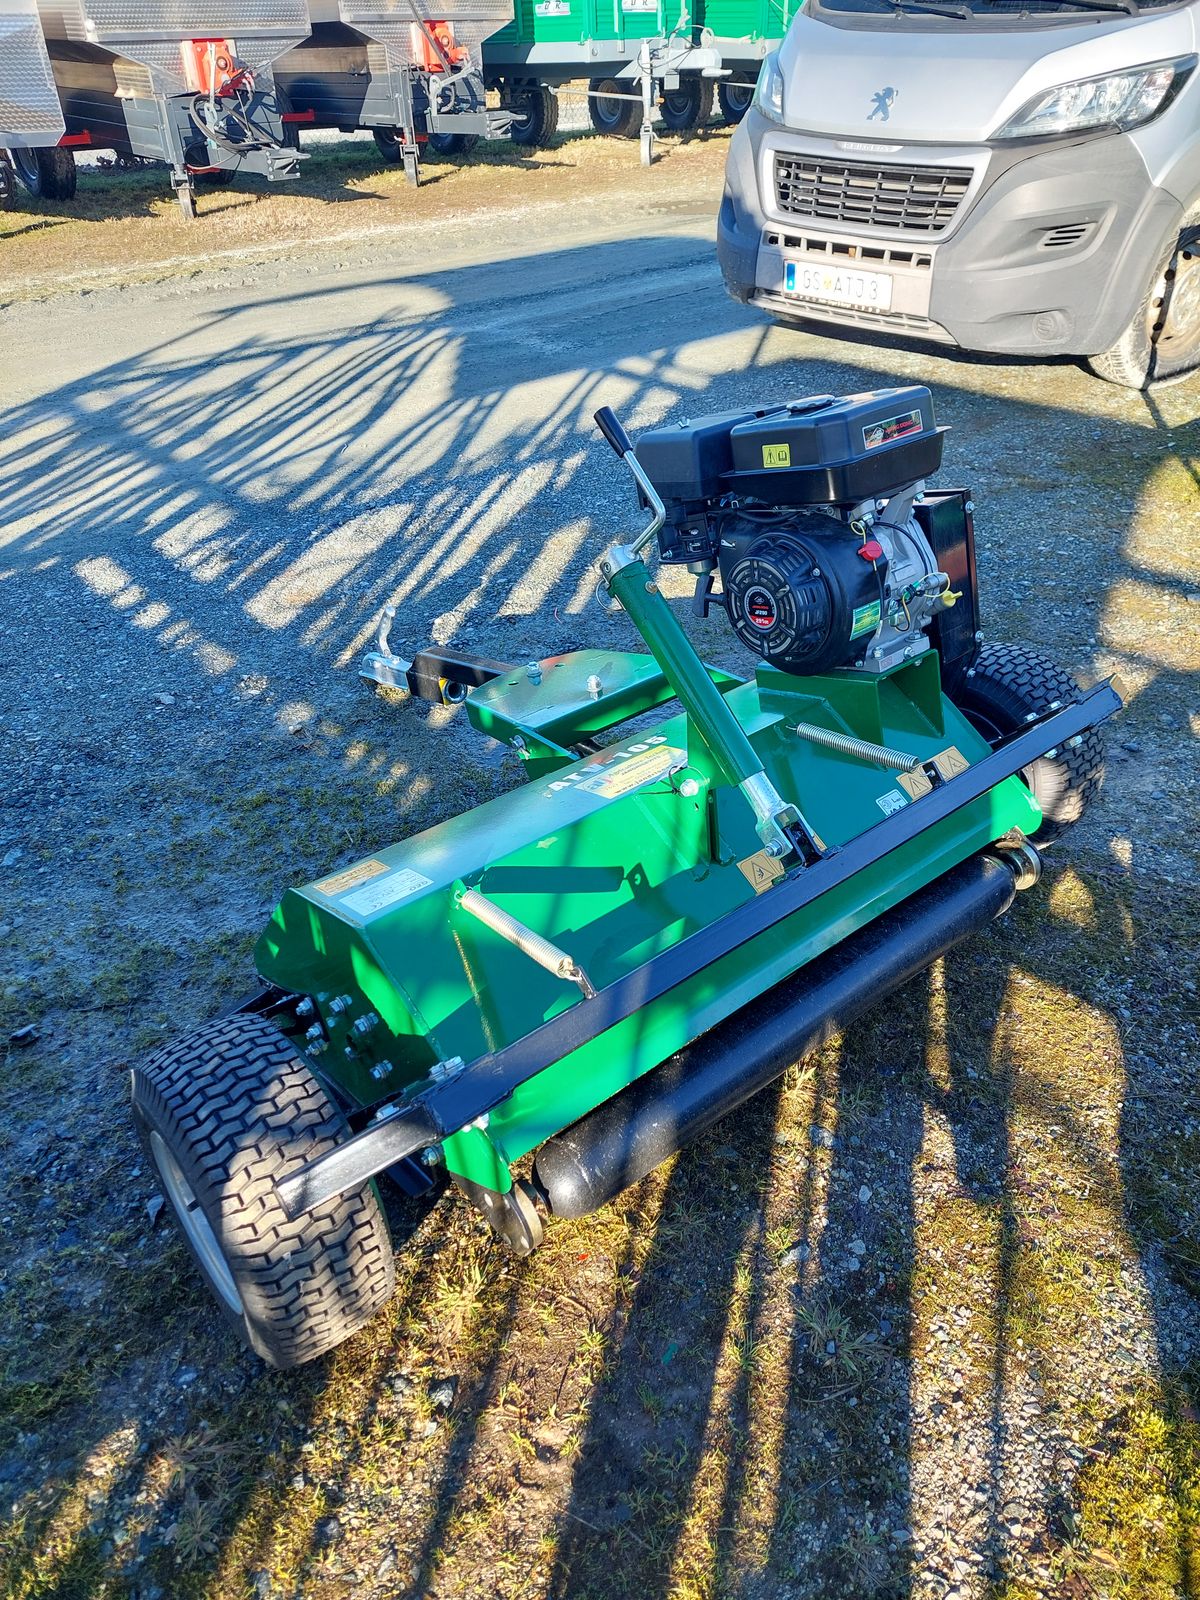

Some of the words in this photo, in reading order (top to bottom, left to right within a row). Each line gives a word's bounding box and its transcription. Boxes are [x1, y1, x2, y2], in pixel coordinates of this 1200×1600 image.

[803, 269, 820, 290] GS
[834, 276, 864, 298] ATJ
[870, 280, 878, 300] 3
[548, 735, 668, 792] ATV-105
